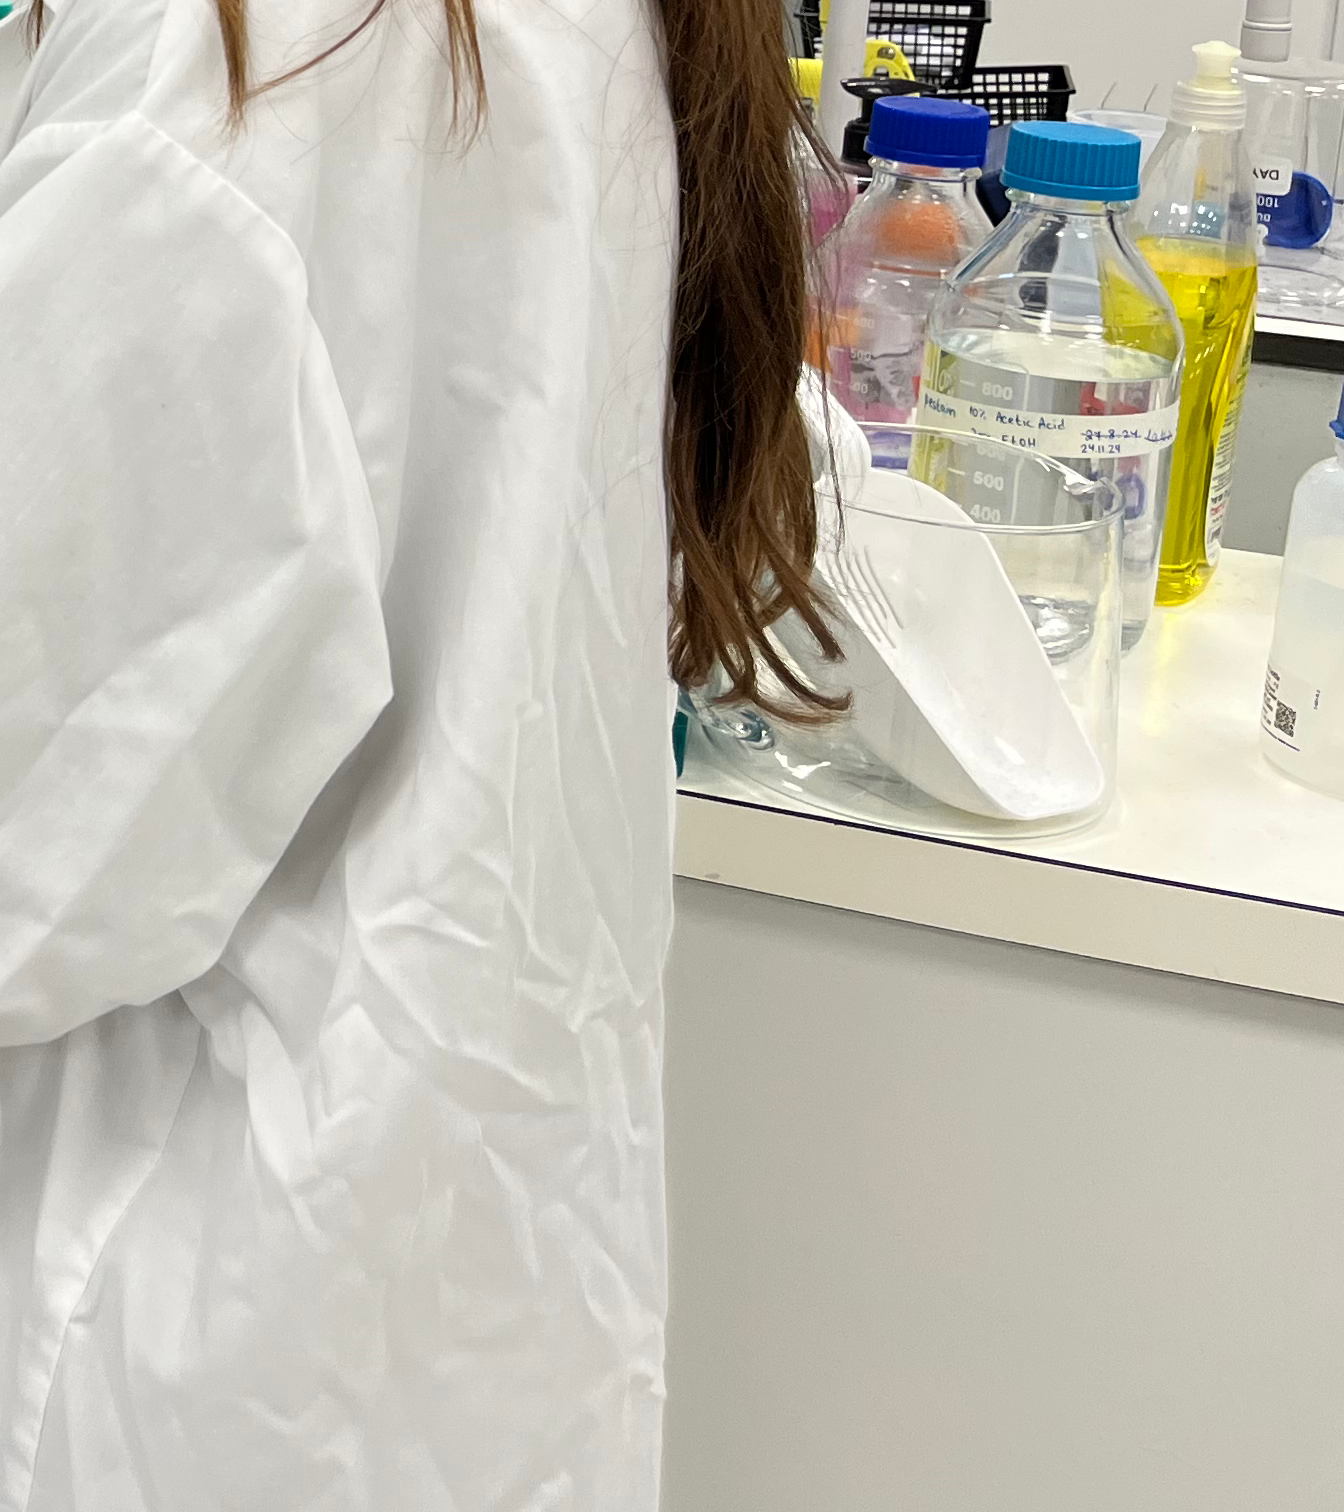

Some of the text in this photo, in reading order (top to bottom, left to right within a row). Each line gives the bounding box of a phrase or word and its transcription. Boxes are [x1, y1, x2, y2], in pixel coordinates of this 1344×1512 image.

[982, 381, 1014, 401] 800
[996, 412, 1031, 430] Acetic
[1038, 417, 1065, 431] Acid
[973, 472, 1005, 491] 500
[969, 504, 1002, 523] 400
